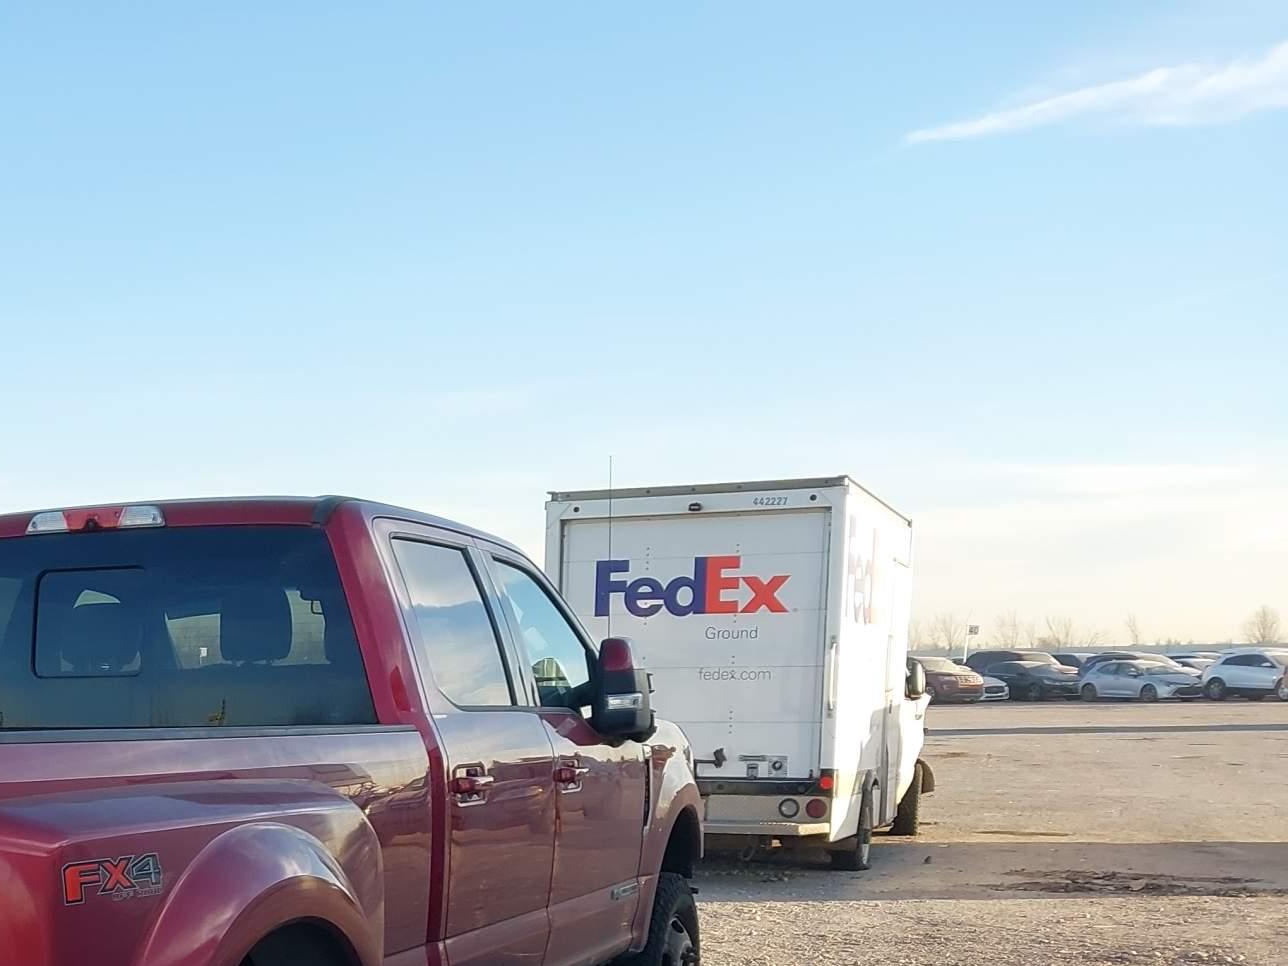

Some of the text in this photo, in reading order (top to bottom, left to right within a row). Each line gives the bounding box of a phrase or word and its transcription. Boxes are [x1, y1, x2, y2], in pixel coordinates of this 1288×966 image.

[752, 496, 788, 506] 442227
[594, 555, 792, 617] FedEx
[704, 626, 759, 640] Ground
[698, 667, 772, 681] fedex.com
[62, 852, 162, 906] FX4
